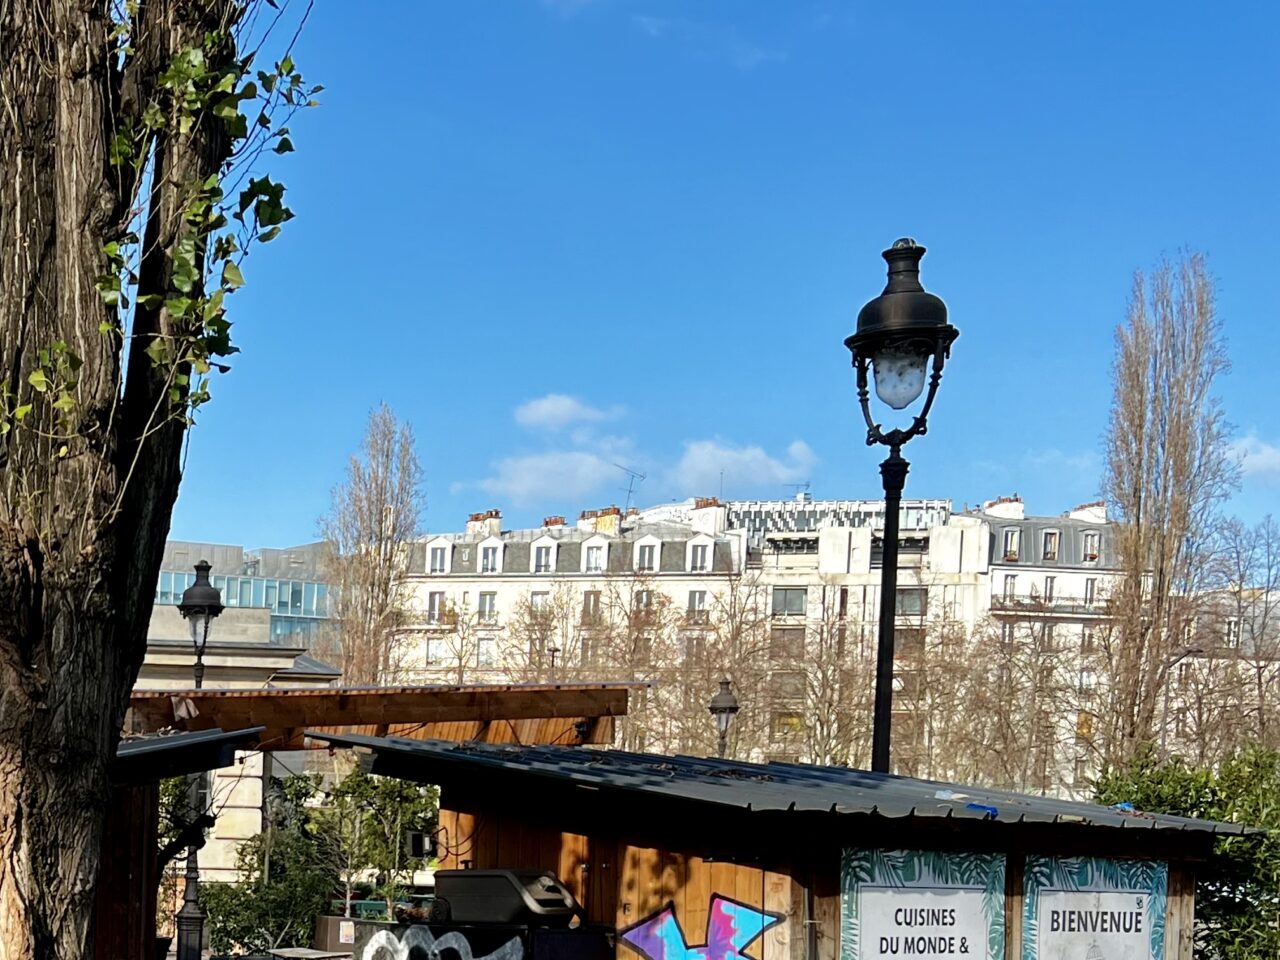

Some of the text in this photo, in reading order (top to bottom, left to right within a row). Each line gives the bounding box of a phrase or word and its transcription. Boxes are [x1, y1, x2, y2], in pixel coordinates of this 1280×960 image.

[894, 907, 956, 927] CUISINES
[1050, 909, 1143, 933] BIENVENUE
[879, 936, 970, 954] DU MONDE &
